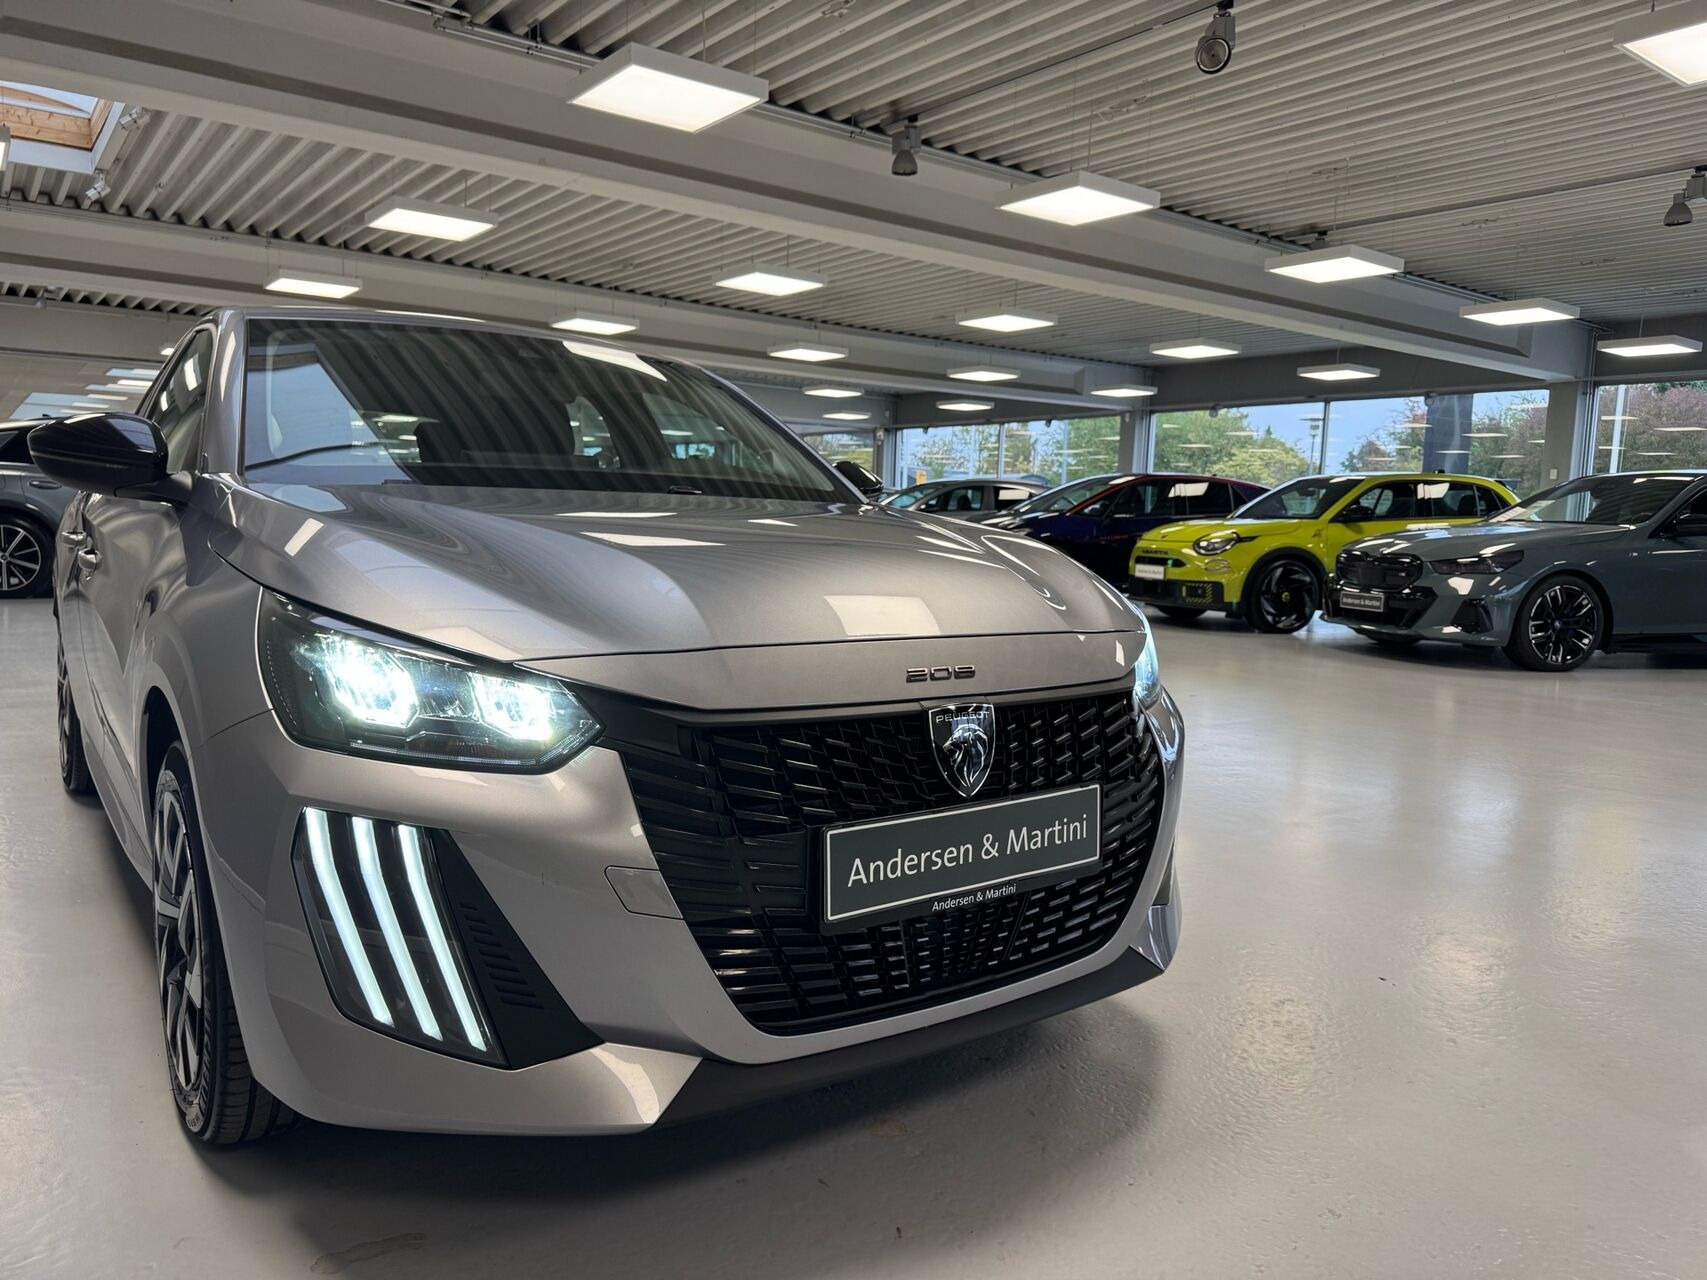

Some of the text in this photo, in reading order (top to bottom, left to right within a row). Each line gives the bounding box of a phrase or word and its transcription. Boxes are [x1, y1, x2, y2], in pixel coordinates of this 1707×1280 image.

[905, 664, 976, 684] 208
[935, 711, 990, 723] PEUGEOT
[847, 814, 1087, 887] Andersen & Martini
[931, 883, 1017, 912] Andersen & Martini
